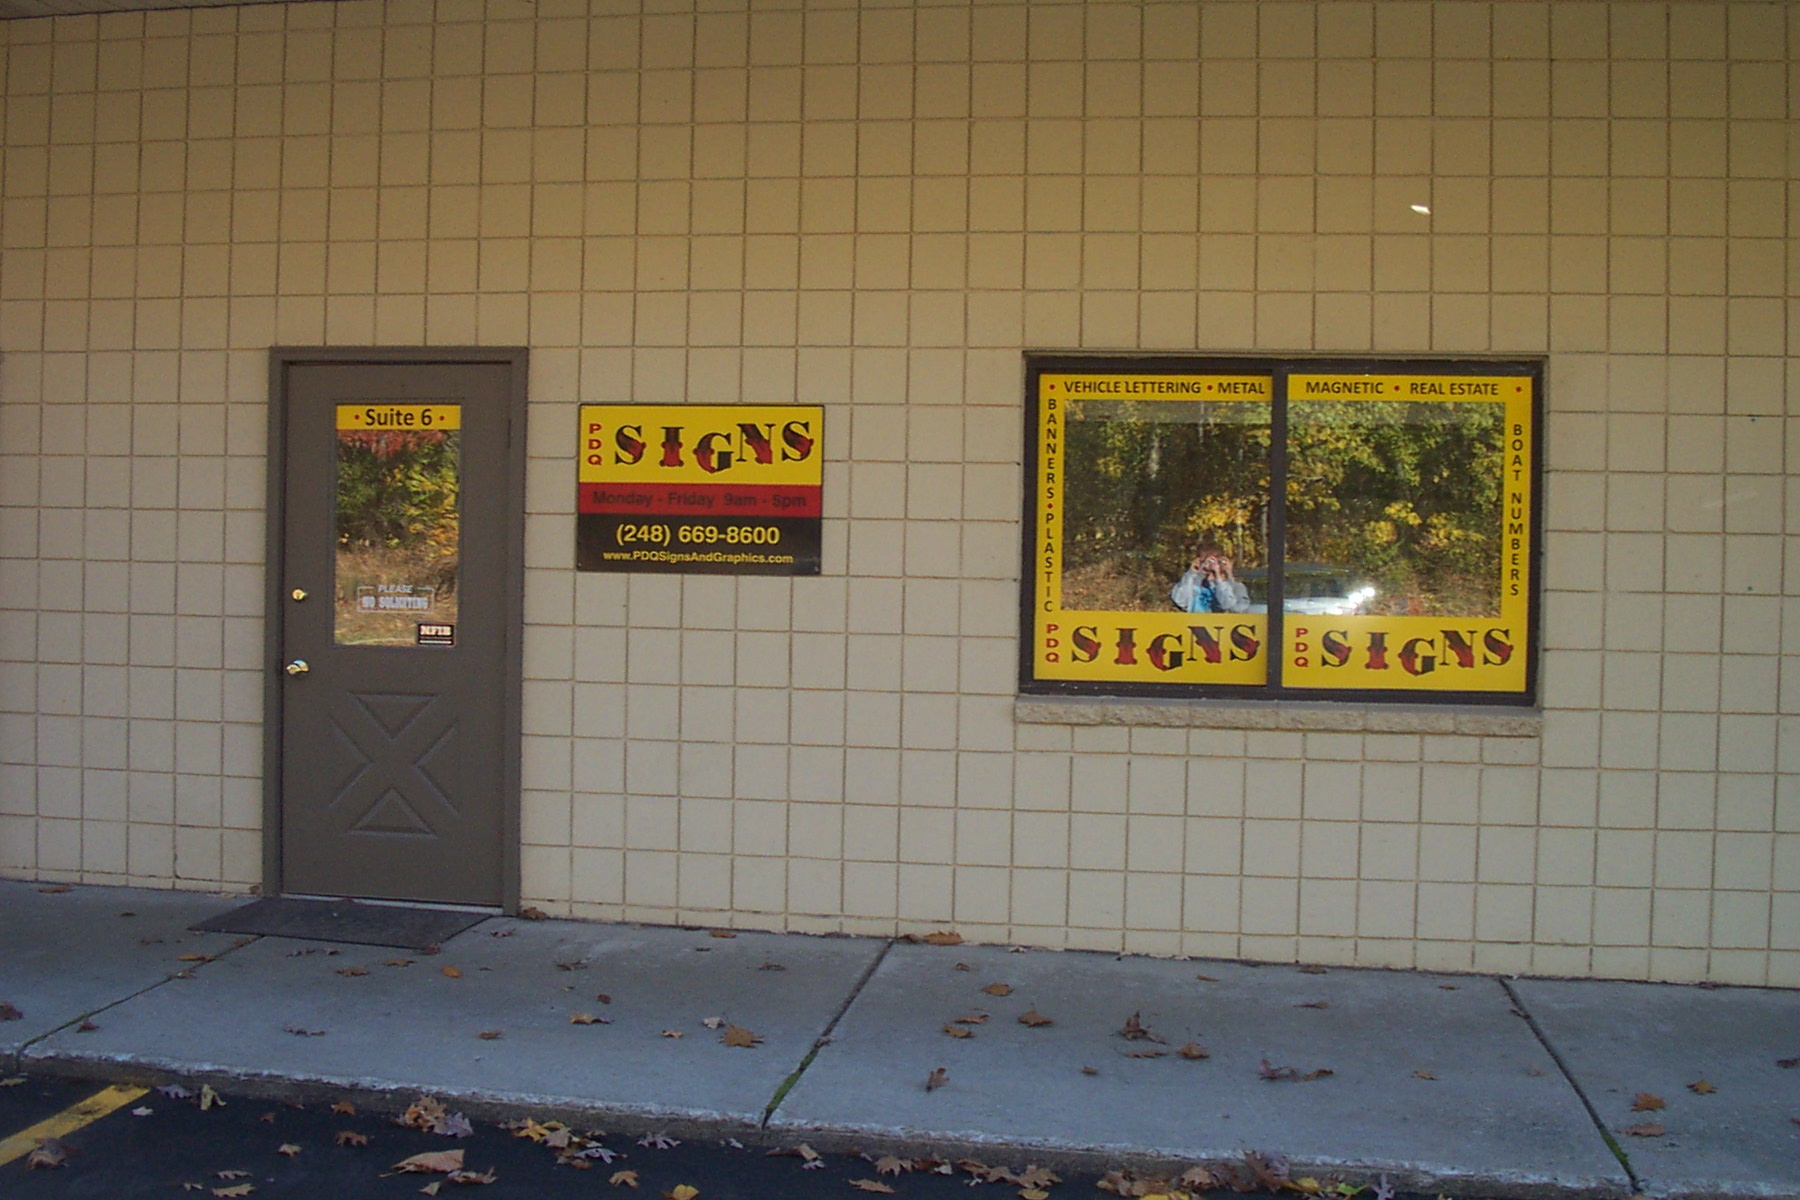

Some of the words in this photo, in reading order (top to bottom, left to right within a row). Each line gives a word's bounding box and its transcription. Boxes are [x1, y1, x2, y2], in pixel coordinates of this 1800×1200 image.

[1064, 381, 1120, 394] VEHICLE
[1125, 381, 1201, 394] LETTERING
[1217, 382, 1265, 394] METAL
[1306, 381, 1384, 394] MAGNETIC
[1410, 382, 1445, 395] REAL
[1450, 382, 1499, 395] ESTATE
[365, 408, 414, 426] Suite
[420, 408, 432, 426] 6
[587, 422, 602, 466] PDQ
[614, 421, 815, 474] SIGNS
[1046, 398, 1057, 499] BANNERS
[1511, 424, 1523, 481] BOAT
[592, 491, 653, 508] Monday
[667, 491, 714, 509] Friday
[724, 492, 757, 506] 9am
[772, 494, 806, 509] 5pm
[615, 523, 671, 547] (248)
[677, 525, 781, 545] 669-8600
[1508, 493, 1523, 596] NUMBERS
[603, 550, 794, 564] www.PDQSignsAndGraphics.com
[1044, 513, 1055, 612] PLASTIC
[378, 585, 414, 594] PLEASE
[1045, 623, 1059, 663] PDQ
[1071, 624, 1260, 671] SIGNS
[1294, 627, 1309, 668] PDQ
[1321, 628, 1514, 676] SIGNS
